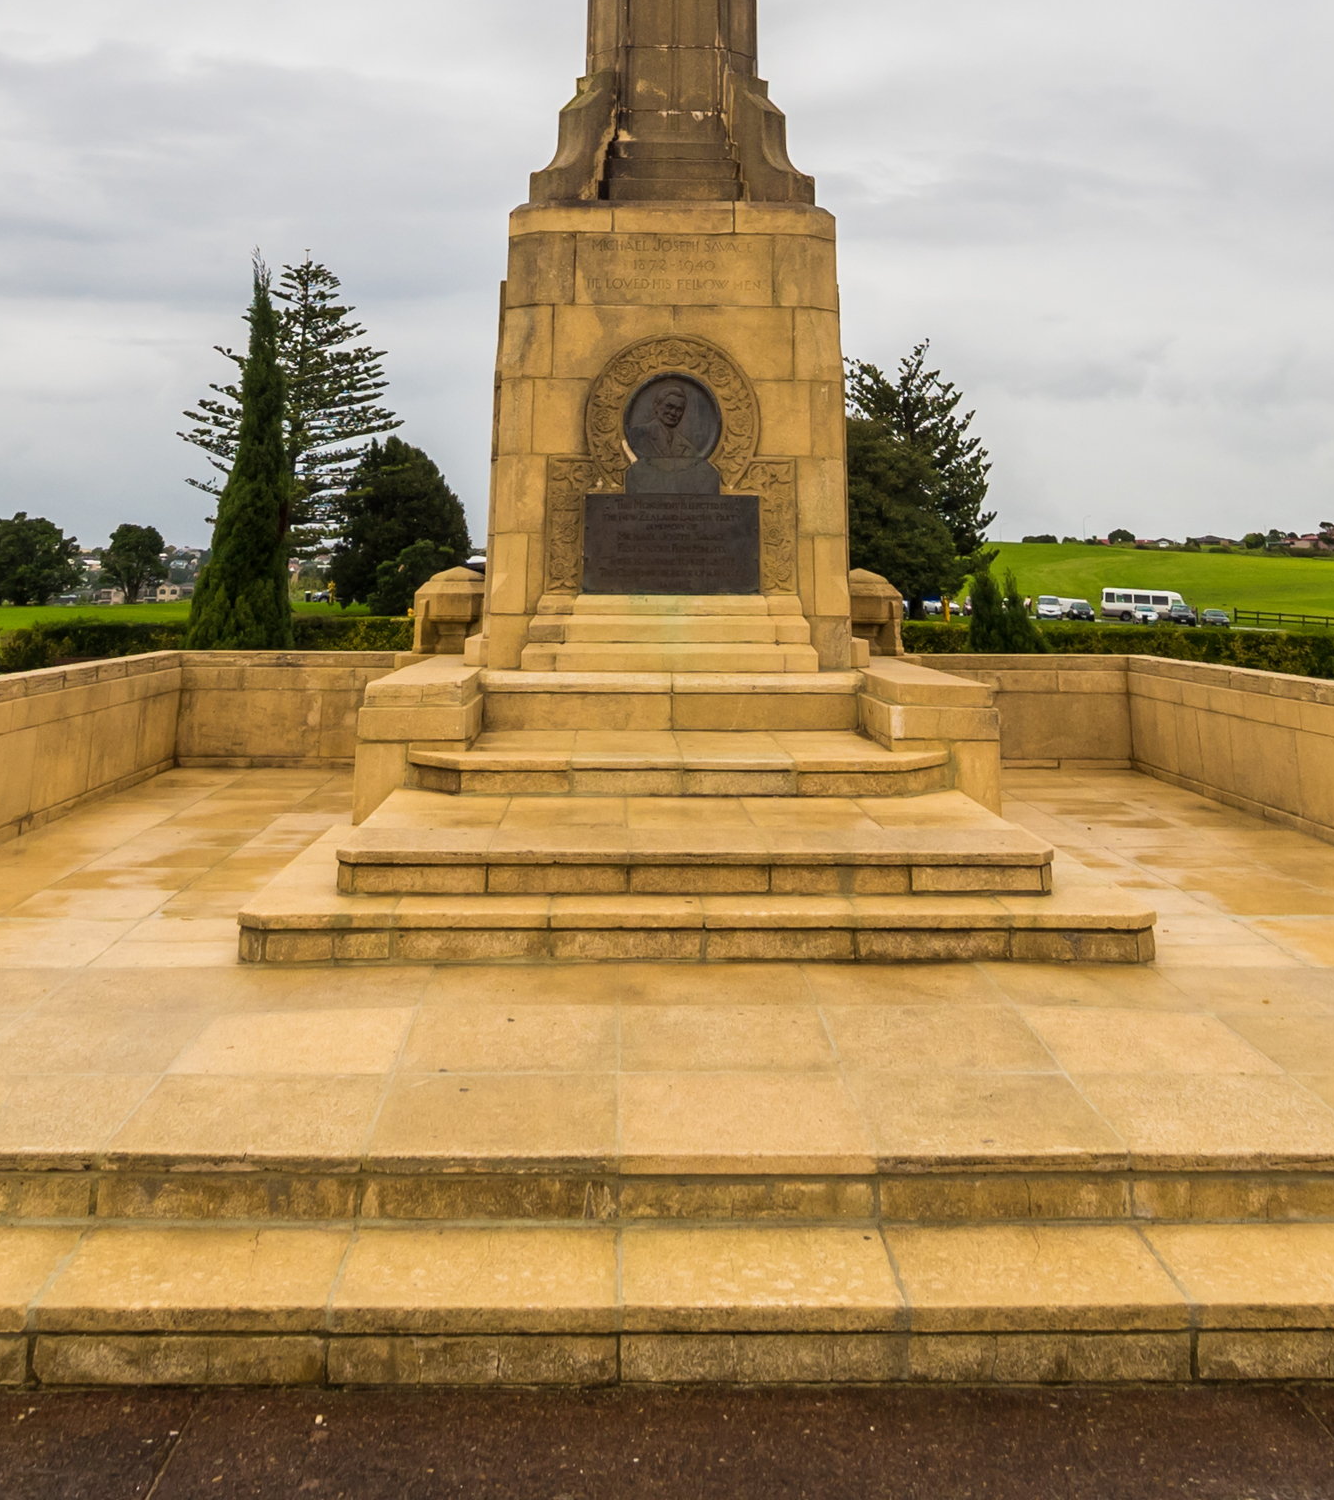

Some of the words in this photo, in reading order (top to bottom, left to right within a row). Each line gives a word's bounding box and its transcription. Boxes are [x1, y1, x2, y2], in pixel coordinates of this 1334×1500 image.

[591, 238, 649, 252] MICHAEL
[653, 237, 699, 253] JOSEPH
[586, 278, 602, 290] HE
[605, 278, 650, 290] LOVED
[652, 278, 671, 290] HIS
[677, 279, 730, 291] FELLOW
[733, 280, 762, 291] MEN
